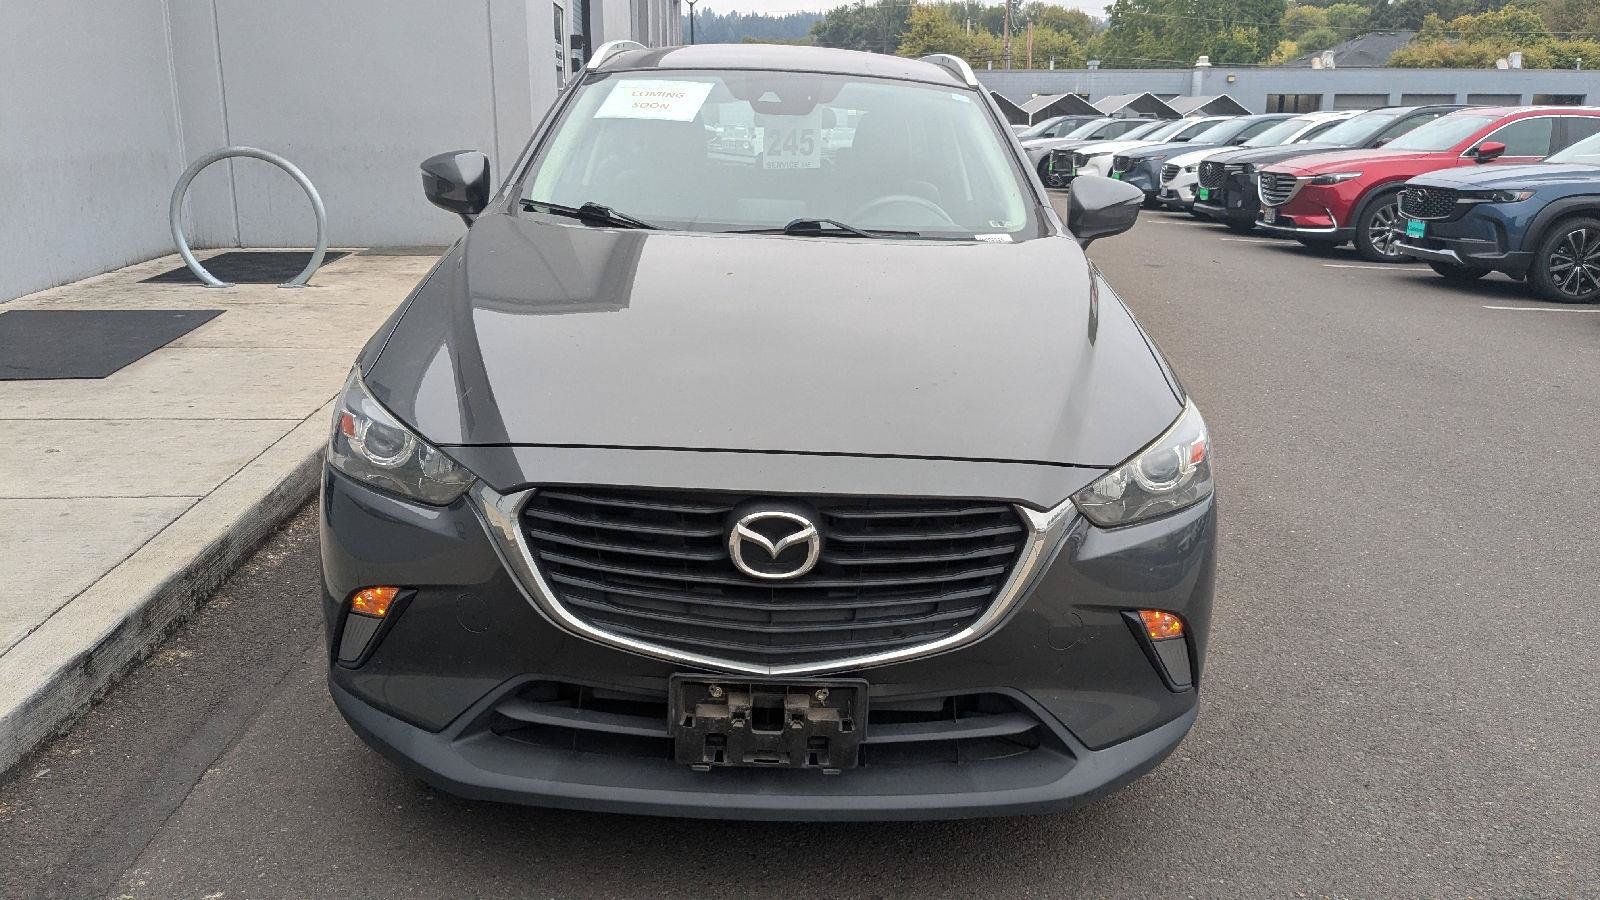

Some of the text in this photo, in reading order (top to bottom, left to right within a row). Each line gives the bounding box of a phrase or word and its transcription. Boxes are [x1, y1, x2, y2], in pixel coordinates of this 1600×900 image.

[631, 90, 686, 99] COMING
[631, 101, 670, 110] SOON
[766, 128, 815, 156] 245
